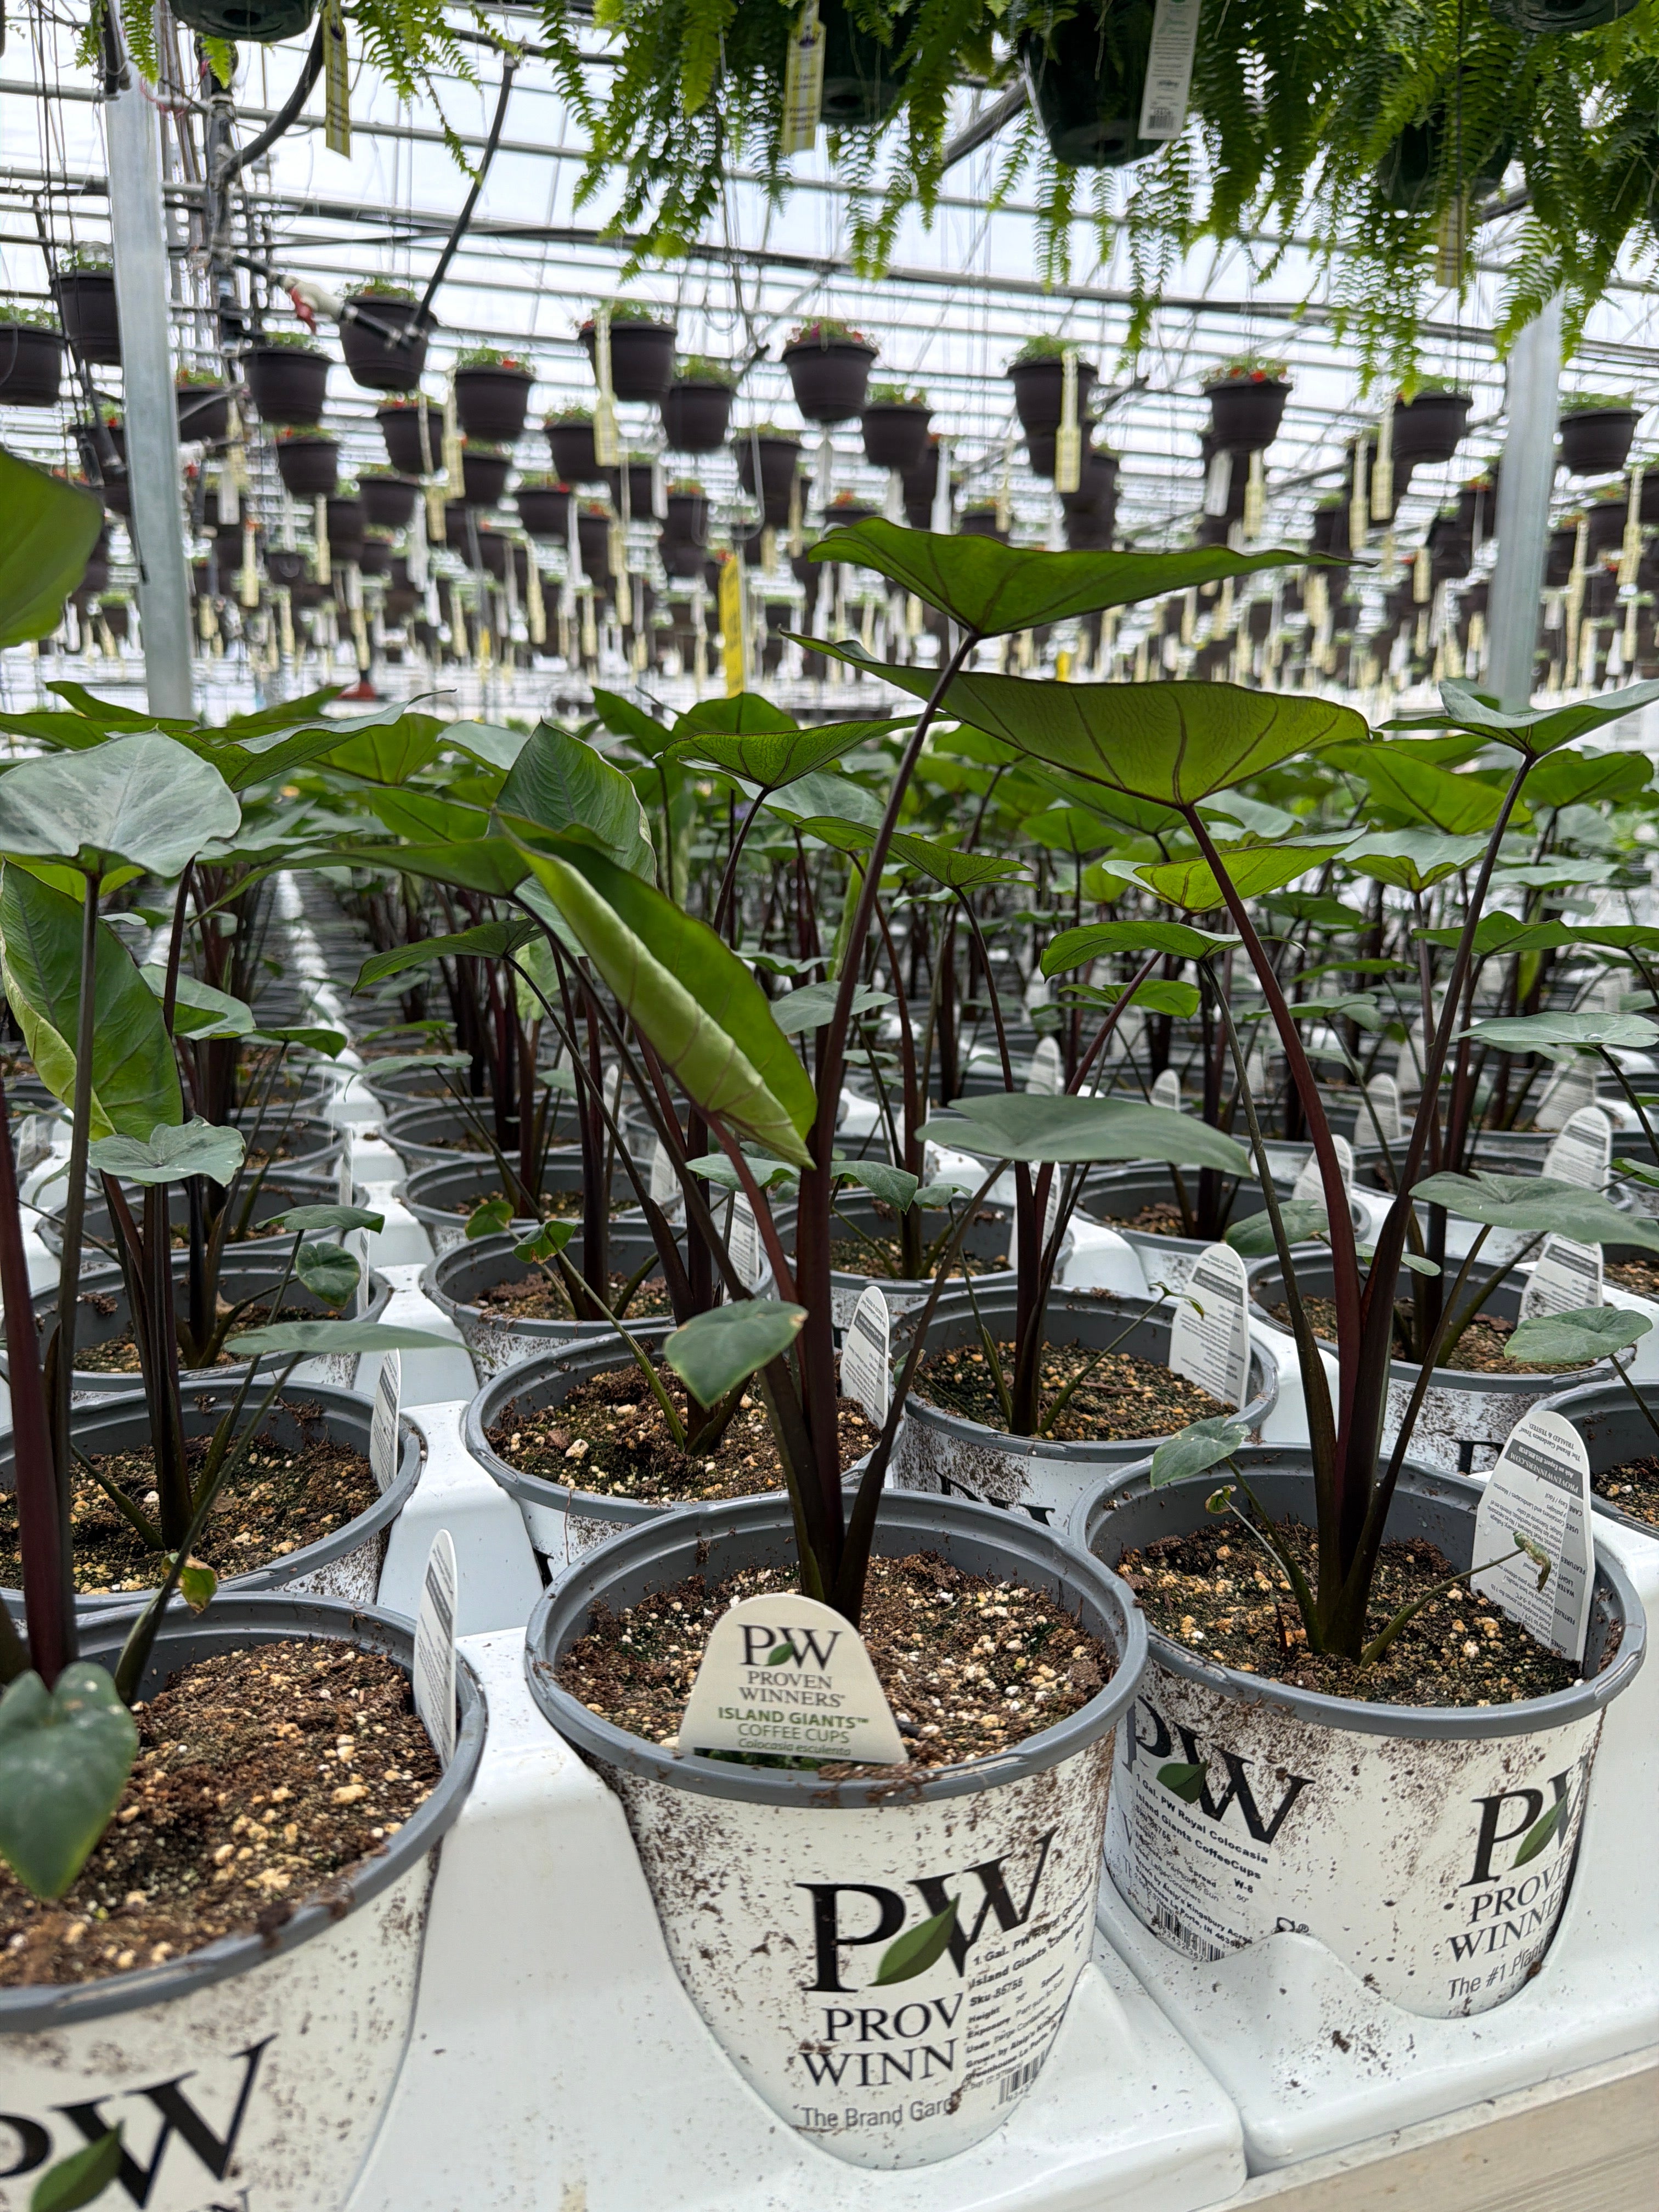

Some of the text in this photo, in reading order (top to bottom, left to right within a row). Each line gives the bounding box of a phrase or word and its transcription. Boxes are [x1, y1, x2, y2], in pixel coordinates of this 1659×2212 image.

[1532, 1432, 1555, 1449] Gardeners
[1553, 1433, 1573, 1451] TRIALED
[1556, 1444, 1570, 1458] Brand
[1510, 1450, 1578, 1494] PROVENWINNERS.COM
[1565, 1468, 1573, 1480] Ask
[1559, 1497, 1567, 1510] Easy
[1568, 1504, 1582, 1517] CARE
[1566, 1522, 1578, 1535] USES
[1561, 1556, 1585, 1575] FEATURES
[1558, 1572, 1573, 1587] LIGHT
[1557, 1582, 1574, 1598] WATER
[1554, 1606, 1575, 1626] FERTILIZE
[737, 1624, 843, 1671] PW
[748, 1670, 832, 1690] PROVEN
[719, 1707, 784, 1723] ISLAND
[737, 1723, 849, 1744] COFFEE CUPS
[738, 1737, 793, 1752] Colocasia
[1136, 1772, 1140, 1782] 1
[1161, 1795, 1175, 1813] PW
[1178, 1808, 1205, 1836] Royal
[1209, 1829, 1268, 1865] Colocasia
[1136, 1788, 1158, 1817] Island
[1161, 1813, 1191, 1843] Giants
[1195, 1838, 1261, 1883] CoffeeCups
[1188, 1864, 1216, 1888] Spread
[1234, 1877, 1253, 1894] W-8
[794, 1826, 1060, 1993] PW
[1187, 1901, 1224, 1933] Kingsbury
[974, 1954, 980, 1967] 1
[1013, 1932, 1030, 1951] PW
[972, 1965, 1009, 1988] Island
[1012, 1946, 1046, 1972] Giants
[1448, 1977, 1481, 2000] The
[1486, 1963, 1506, 1987] #1
[969, 1991, 991, 2008] Sku
[822, 1993, 963, 2042] PROV
[998, 2046, 1007, 2056] by
[799, 2038, 958, 2086] WINN
[801, 2107, 838, 2128] The
[845, 2103, 902, 2128] Brand
